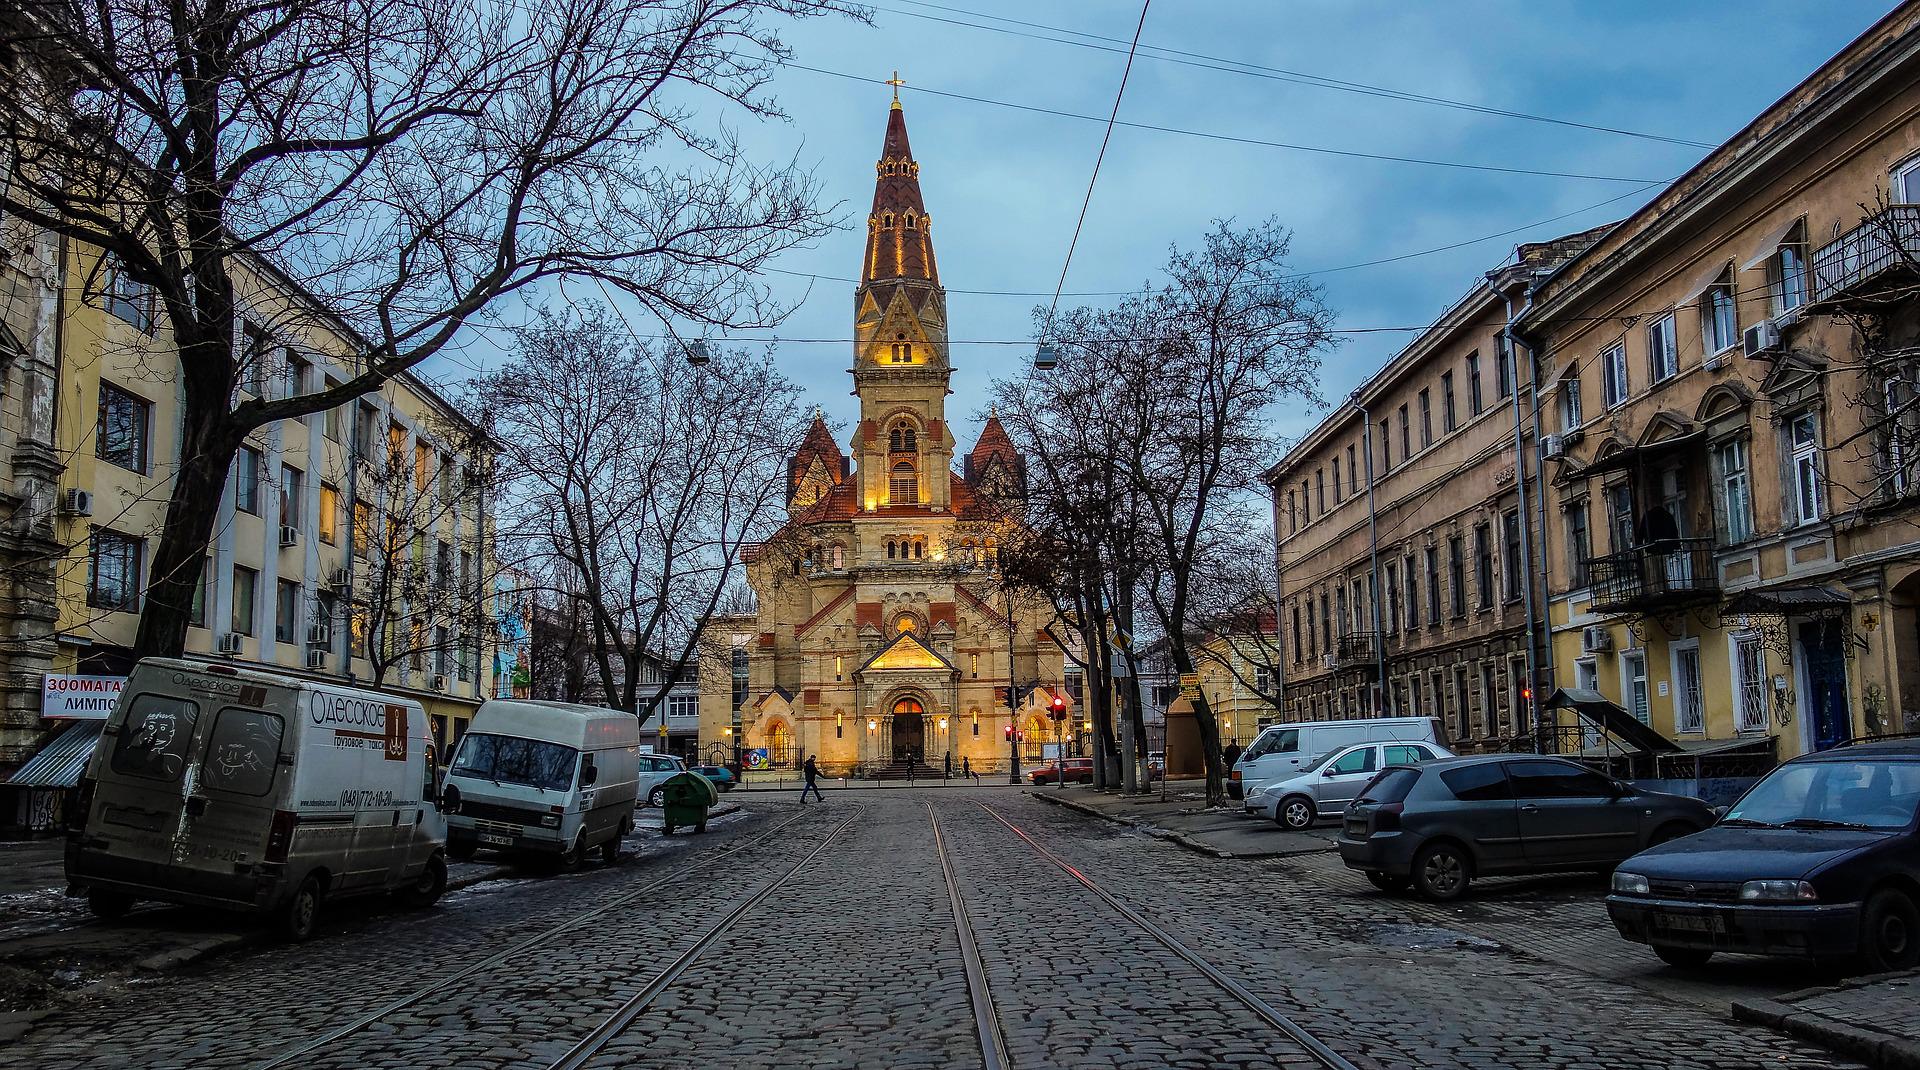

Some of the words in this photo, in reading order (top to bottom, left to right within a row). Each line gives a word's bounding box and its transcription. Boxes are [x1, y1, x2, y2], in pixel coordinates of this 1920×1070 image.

[47, 678, 126, 693] ЗООМАГА
[172, 672, 240, 693] Одесское
[310, 689, 385, 728] Одесское
